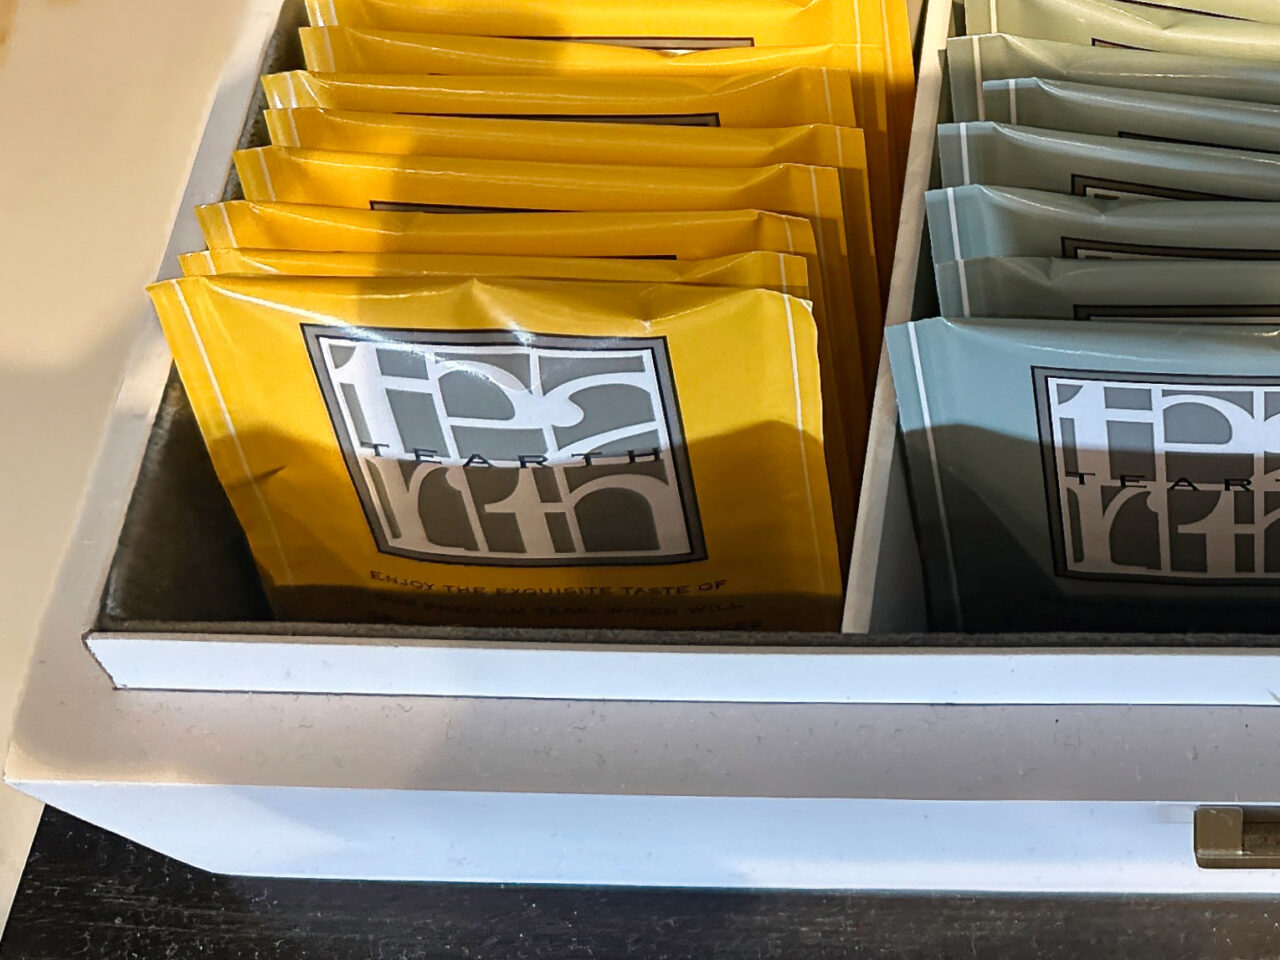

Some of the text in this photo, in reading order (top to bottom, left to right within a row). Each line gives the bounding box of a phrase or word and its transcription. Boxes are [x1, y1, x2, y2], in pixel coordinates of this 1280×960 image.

[360, 443, 661, 468] TEARTH
[370, 570, 434, 591] ENJOY
[442, 584, 486, 595] THE
[618, 585, 689, 595] TASTE
[698, 579, 728, 591] OF
